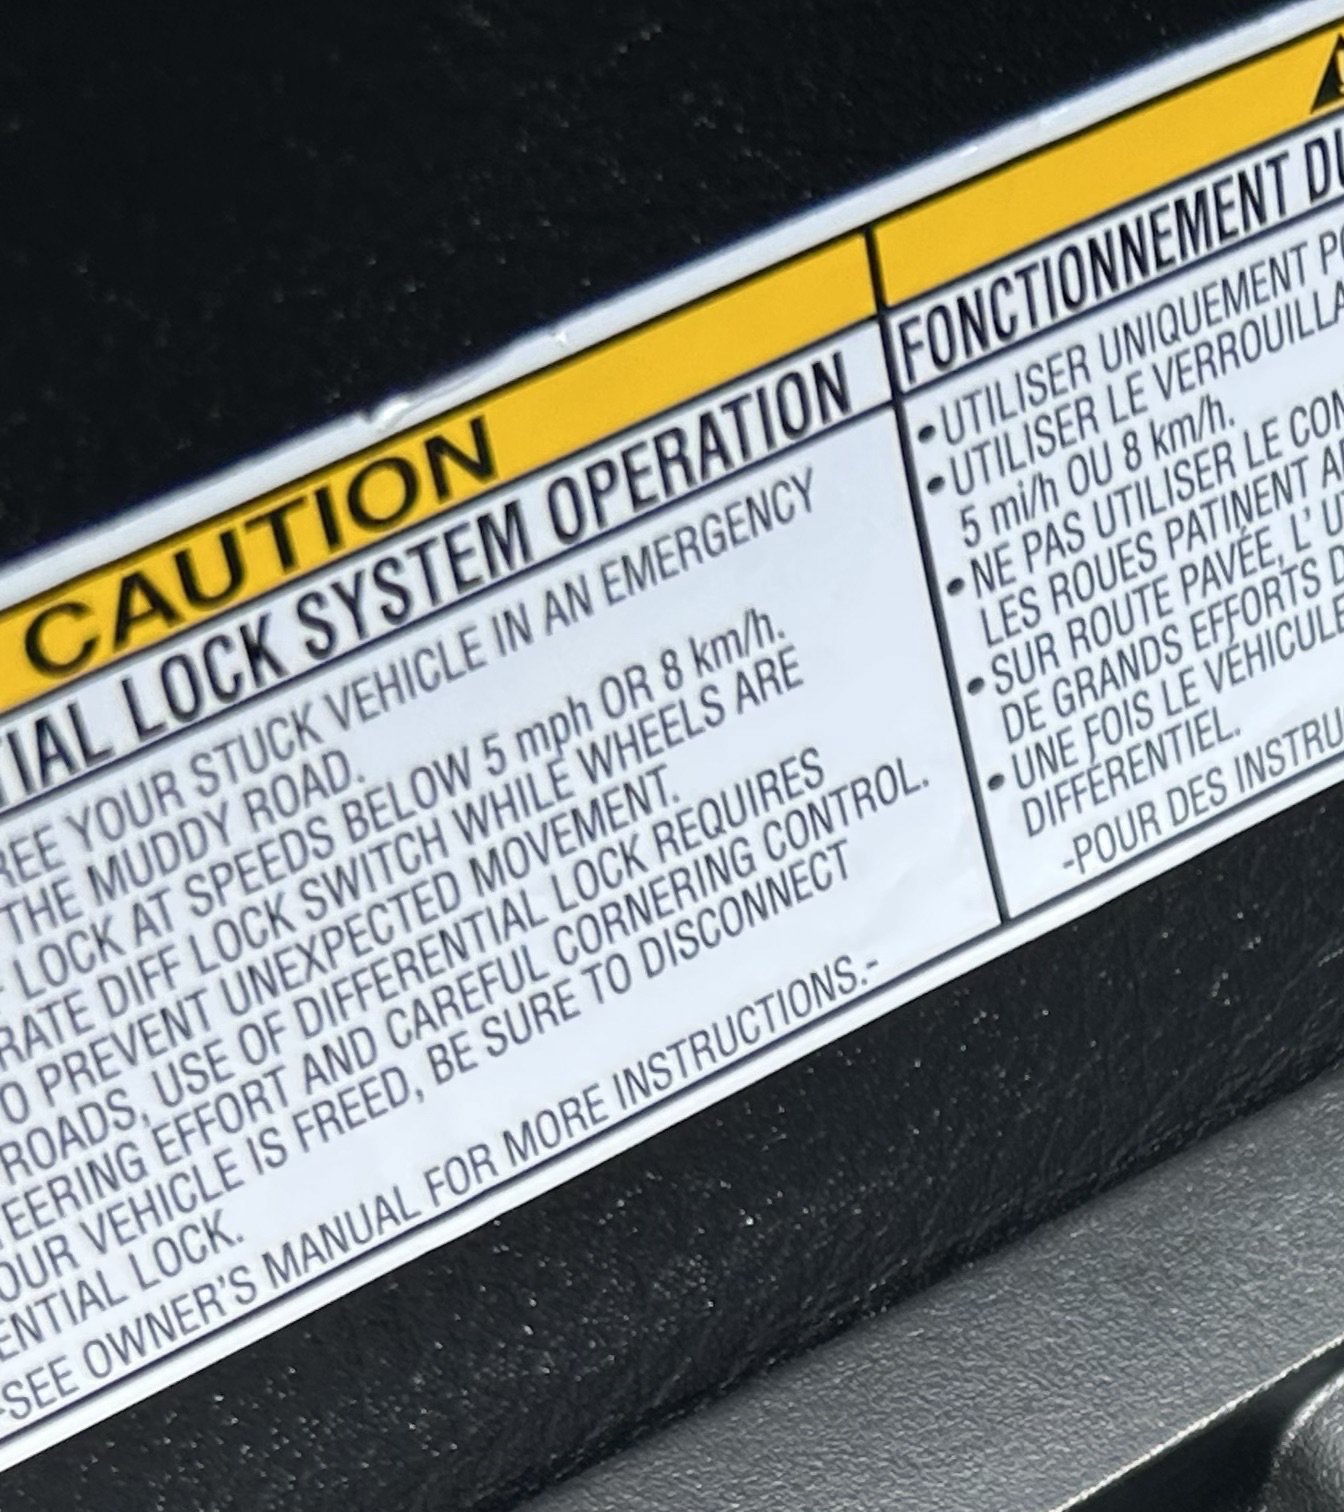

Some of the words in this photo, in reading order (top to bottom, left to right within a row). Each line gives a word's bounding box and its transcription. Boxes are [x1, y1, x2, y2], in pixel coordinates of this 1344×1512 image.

[897, 150, 1290, 385] FONCTIONNEMENT
[939, 343, 1092, 447] UTILISER
[1097, 240, 1309, 374] UNIQUEMENT
[948, 394, 1101, 497] UTILISER
[1105, 369, 1149, 426] LE
[959, 503, 982, 549] 5
[989, 471, 1060, 536] mi/h
[1066, 440, 1114, 498] OU
[1121, 429, 1143, 473] 8
[1148, 393, 1236, 461] km/h.
[969, 541, 1018, 600] NE
[1020, 509, 1086, 575] PAS
[1091, 439, 1237, 540] UTILISER
[1242, 415, 1284, 471] LE
[23, 414, 497, 678] CAUTION
[120, 612, 289, 743] LOCK
[295, 499, 534, 661] SYSTEM
[546, 350, 852, 546] OPERATION
[979, 584, 1042, 649] LES
[1047, 529, 1158, 616] ROUES
[1163, 454, 1310, 561] PATINENT
[990, 631, 1061, 697] SUR
[1065, 573, 1174, 661] ROUTE
[1178, 524, 1285, 607] PAVÉE,
[64, 769, 186, 853] YOUR
[188, 701, 325, 798] STUCK
[322, 624, 488, 732] VEHICLE
[490, 601, 535, 658] IN
[544, 573, 595, 637] AN
[598, 466, 814, 607] EMERGENCY
[1000, 688, 1047, 746] DE
[1051, 622, 1184, 719] GRANDS
[1188, 556, 1322, 653] EFFORTS
[1010, 724, 1080, 791] UNE
[1082, 688, 1155, 760] FOIS
[1159, 665, 1201, 718] LE
[0, 875, 84, 945] THE
[85, 800, 231, 907] MUDDY
[240, 748, 366, 833] ROAD.
[11, 914, 127, 1001] LOCK
[131, 886, 174, 948] AT
[183, 814, 336, 919] SPEEDS
[340, 744, 472, 845] BELOW
[480, 731, 508, 777] 5
[514, 695, 594, 763] mph
[598, 663, 655, 720] OR
[659, 647, 684, 692] 8
[687, 606, 786, 679] km/h.
[96, 943, 181, 1020] DIFF
[187, 891, 297, 976] LOCK
[298, 816, 450, 922] SWITCH
[450, 753, 575, 846] WHILE
[574, 683, 726, 786] WHEELS
[735, 644, 805, 715] ARE
[1021, 705, 1242, 839] DIFFÉRENTIEL.
[1062, 799, 1163, 875] -POUR
[1165, 765, 1228, 828] DES
[0, 1087, 150, 1186] ROADS,
[150, 1038, 236, 1109] USE
[237, 1009, 286, 1067] OF
[291, 888, 550, 1041] DIFFERENTIAL
[549, 832, 649, 914] LOCK
[650, 746, 825, 864] REQUIRES
[35, 987, 211, 1108] PREVENT
[218, 869, 462, 1017] UNEXPECTED
[467, 763, 681, 898] MOVEMENT.
[150, 1064, 289, 1167] EFFORT
[302, 1025, 378, 1096] AND
[384, 944, 551, 1050] CAREFUL
[552, 835, 758, 967] CORNERING
[762, 756, 930, 863] CONTROL.
[78, 1147, 245, 1255] VEHICLE
[245, 1125, 288, 1176] IS
[290, 1065, 425, 1154] FREED,
[425, 1029, 479, 1086] BE
[480, 977, 582, 1058] SURE
[580, 952, 632, 1005] TO
[637, 837, 849, 980] DISCONNECT
[260, 1185, 423, 1290] MANUAL
[422, 1142, 500, 1208] FOR
[501, 1082, 610, 1168] MORE
[611, 954, 879, 1111] INSTRUCTIONS.-
[127, 1208, 245, 1292] LOCK.
